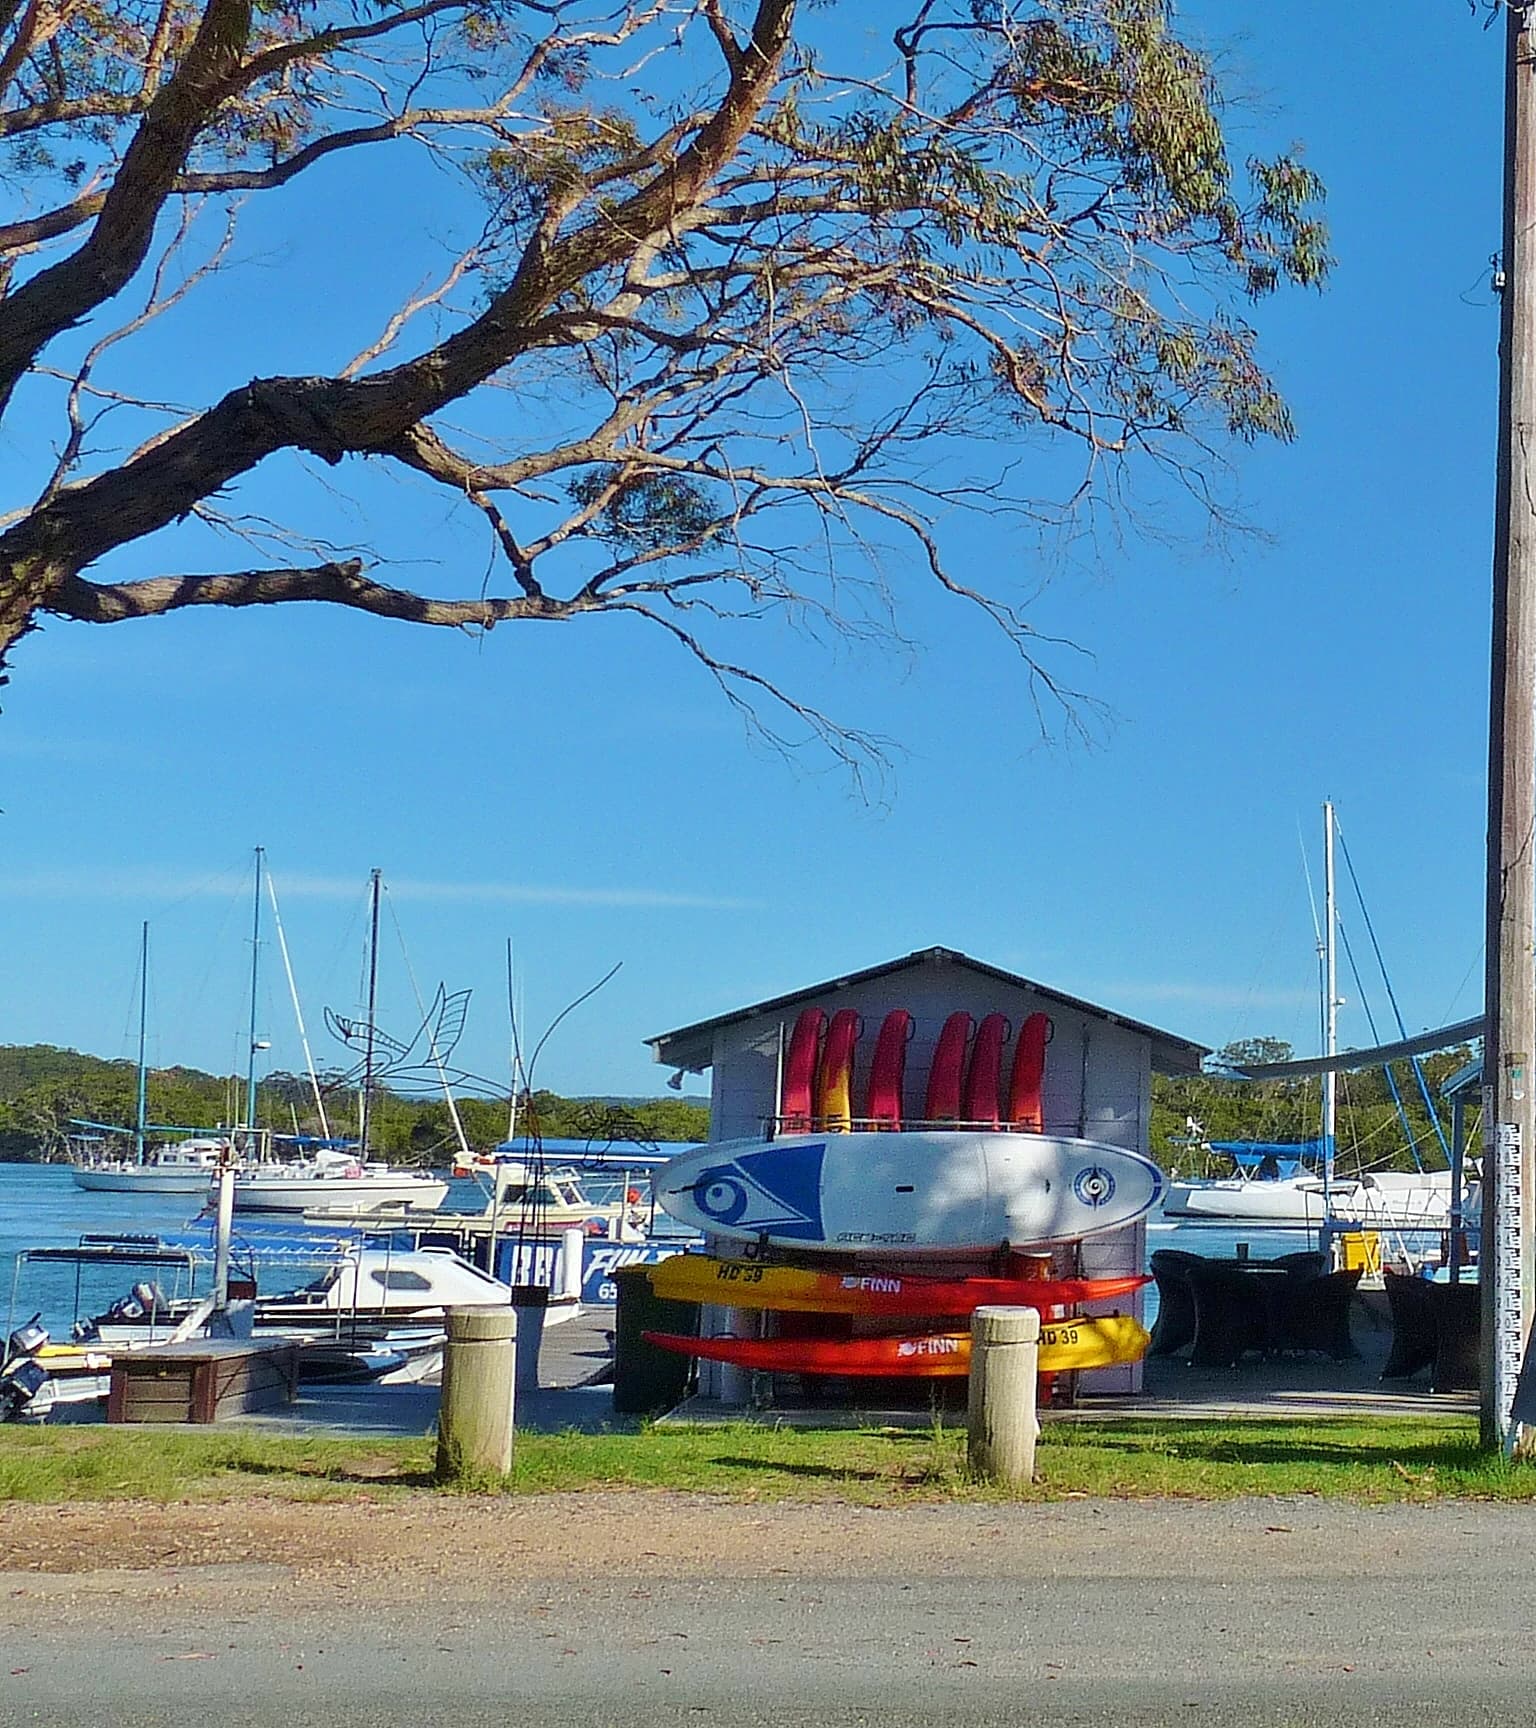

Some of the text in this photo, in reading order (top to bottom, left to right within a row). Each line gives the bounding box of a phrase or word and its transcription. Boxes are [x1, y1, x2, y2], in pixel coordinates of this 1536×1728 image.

[860, 1277, 901, 1293] FINN
[1060, 1329, 1078, 1345] 39
[917, 1338, 959, 1354] FINN
